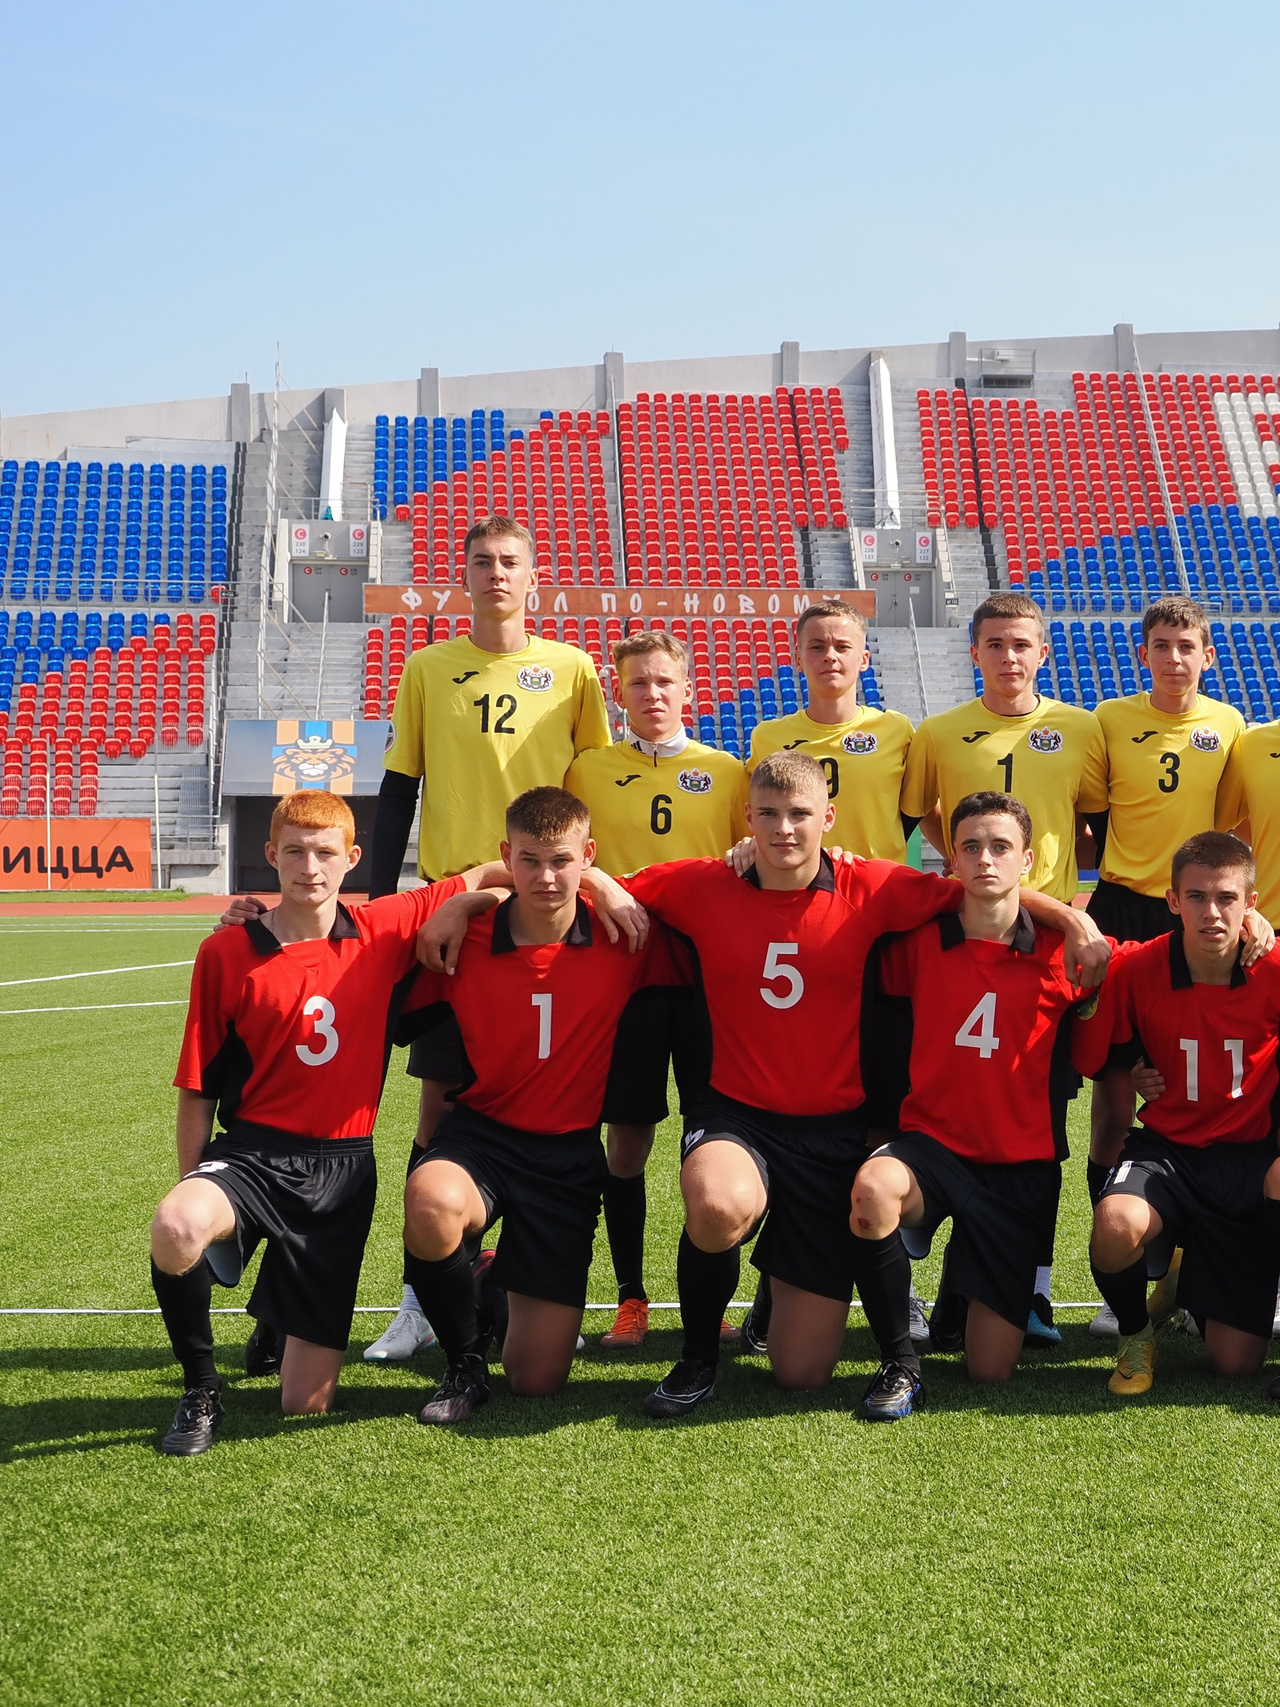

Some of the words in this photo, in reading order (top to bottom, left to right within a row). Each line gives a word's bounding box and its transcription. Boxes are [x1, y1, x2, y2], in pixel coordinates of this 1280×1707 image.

[401, 587, 568, 612] ФУОЛ
[473, 693, 517, 735] 12
[818, 757, 840, 800] 9
[997, 753, 1014, 793] 1
[1158, 753, 1181, 794] 3
[650, 794, 672, 836] 6
[3, 845, 135, 879] ИЦЦА
[759, 942, 804, 1009] 5
[295, 995, 339, 1066] 3
[531, 993, 552, 1059] 1
[954, 992, 1000, 1059] 4
[1179, 1038, 1245, 1102] 11
